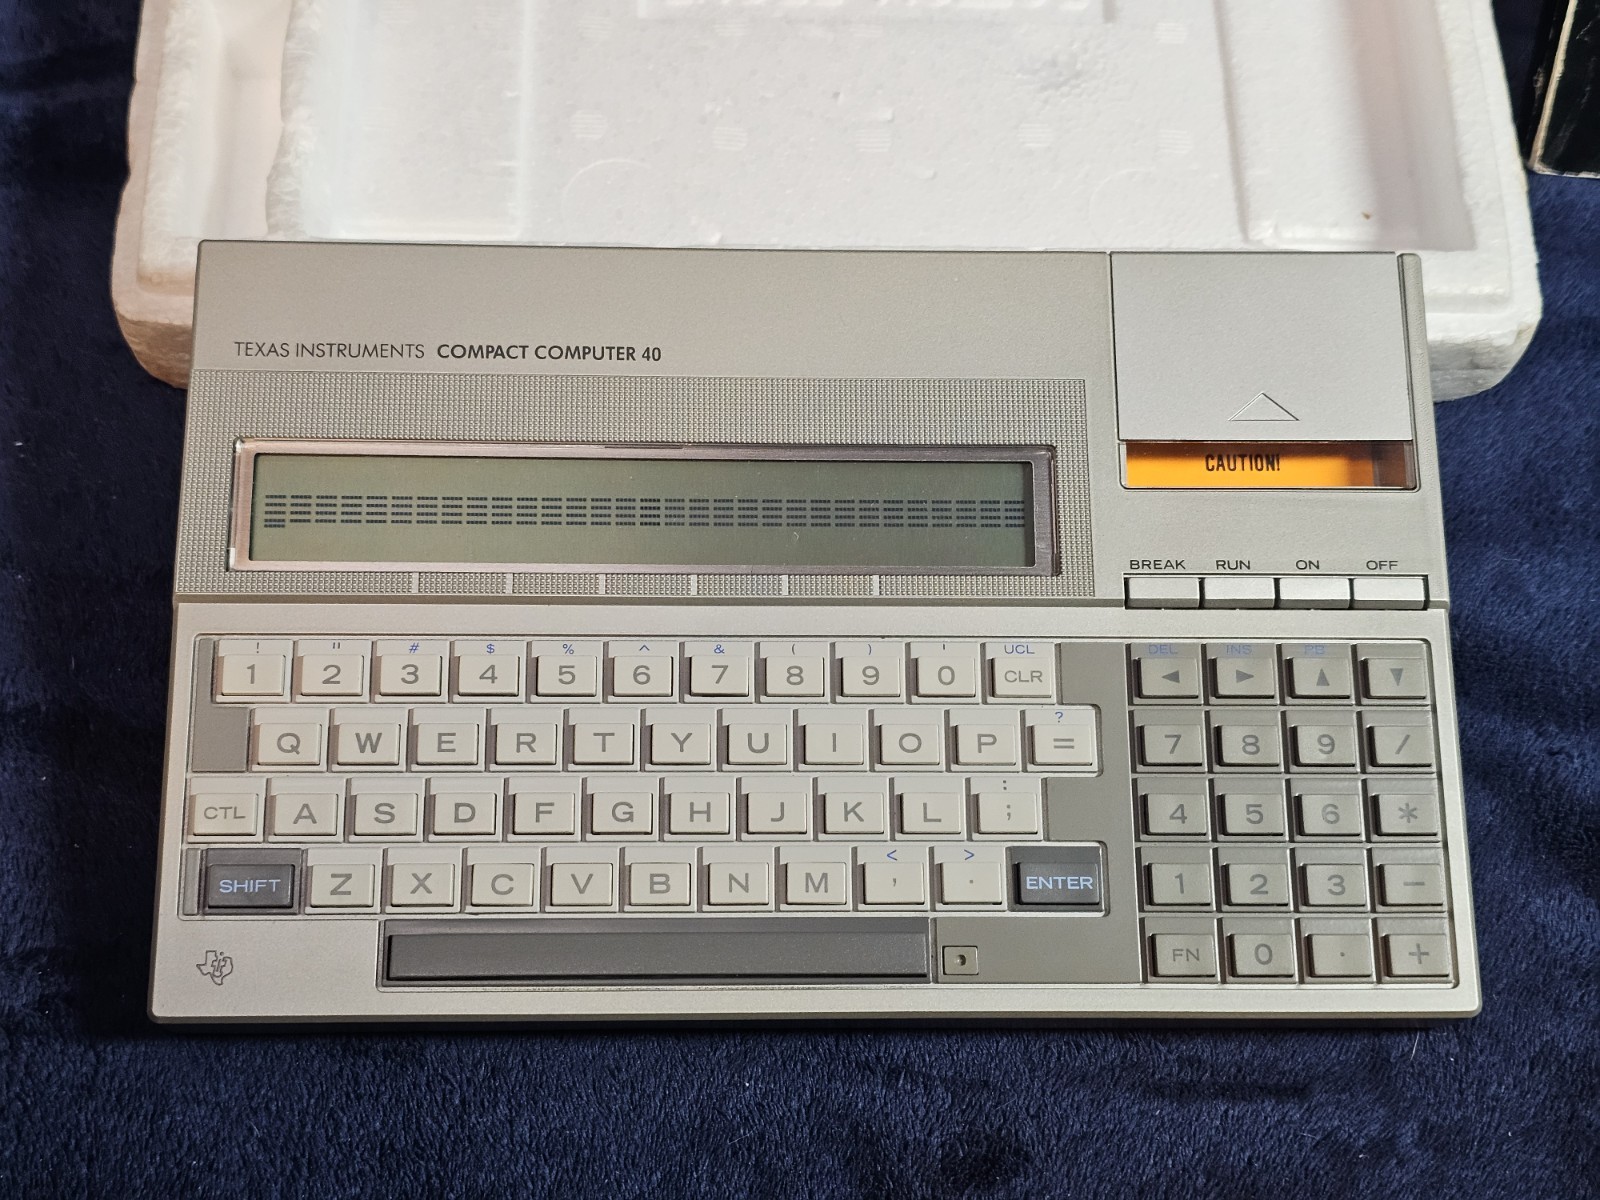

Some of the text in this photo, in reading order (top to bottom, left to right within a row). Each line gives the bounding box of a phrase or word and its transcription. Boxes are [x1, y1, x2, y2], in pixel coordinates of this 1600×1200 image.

[234, 341, 662, 362] TEXAS INSTRUMENTS COMPACT COMPUTER 40
[1205, 454, 1281, 472] CAUTION!
[1129, 560, 1186, 570] BREAK
[1215, 560, 1251, 570] RUN
[1295, 560, 1320, 570] ON
[1366, 560, 1399, 571] OFF
[1003, 644, 1035, 655] UCL
[1148, 644, 1178, 655] DEL
[1226, 644, 1253, 655] INS
[1304, 644, 1326, 655] PB
[246, 663, 257, 684] 1
[322, 664, 341, 685] 2
[400, 664, 420, 684] 3
[478, 664, 498, 684] 4
[557, 664, 576, 685] 5
[632, 664, 651, 685] 6
[710, 665, 729, 684] 7
[785, 665, 805, 686] 8
[861, 665, 880, 686] 9
[936, 666, 956, 686] 0
[1004, 670, 1043, 683] CLR
[276, 732, 301, 755] Q
[354, 732, 383, 754] W
[437, 732, 457, 753] E
[515, 732, 537, 753] R
[592, 732, 615, 753] T
[670, 732, 693, 753] Y
[747, 732, 769, 754] U
[831, 732, 837, 753] I
[898, 732, 922, 754] O
[977, 732, 997, 753] P
[1164, 734, 1182, 754] 7
[1241, 734, 1261, 755] 8
[1317, 734, 1336, 754] 9
[203, 805, 246, 820] CTL
[293, 803, 317, 824] A
[373, 802, 396, 824] S
[454, 802, 476, 823] D
[535, 802, 555, 823] F
[611, 801, 635, 823] G
[689, 802, 711, 822] H
[770, 801, 786, 823] J
[843, 801, 865, 822] K
[923, 801, 942, 822] L
[1169, 804, 1188, 824] 4
[1245, 804, 1264, 825] 5
[1321, 804, 1340, 825] 6
[218, 878, 282, 893] SHIFT
[329, 873, 353, 896] Z
[409, 873, 434, 895] X
[490, 873, 515, 895] C
[570, 873, 594, 895] V
[649, 873, 671, 894] B
[728, 872, 750, 893] N
[805, 872, 829, 893] M
[1025, 875, 1094, 890] ENTER
[1174, 873, 1185, 894] 1
[1249, 874, 1269, 895] 2
[1327, 875, 1346, 895] 3
[1172, 948, 1200, 962] FN
[1254, 944, 1273, 966] 0
